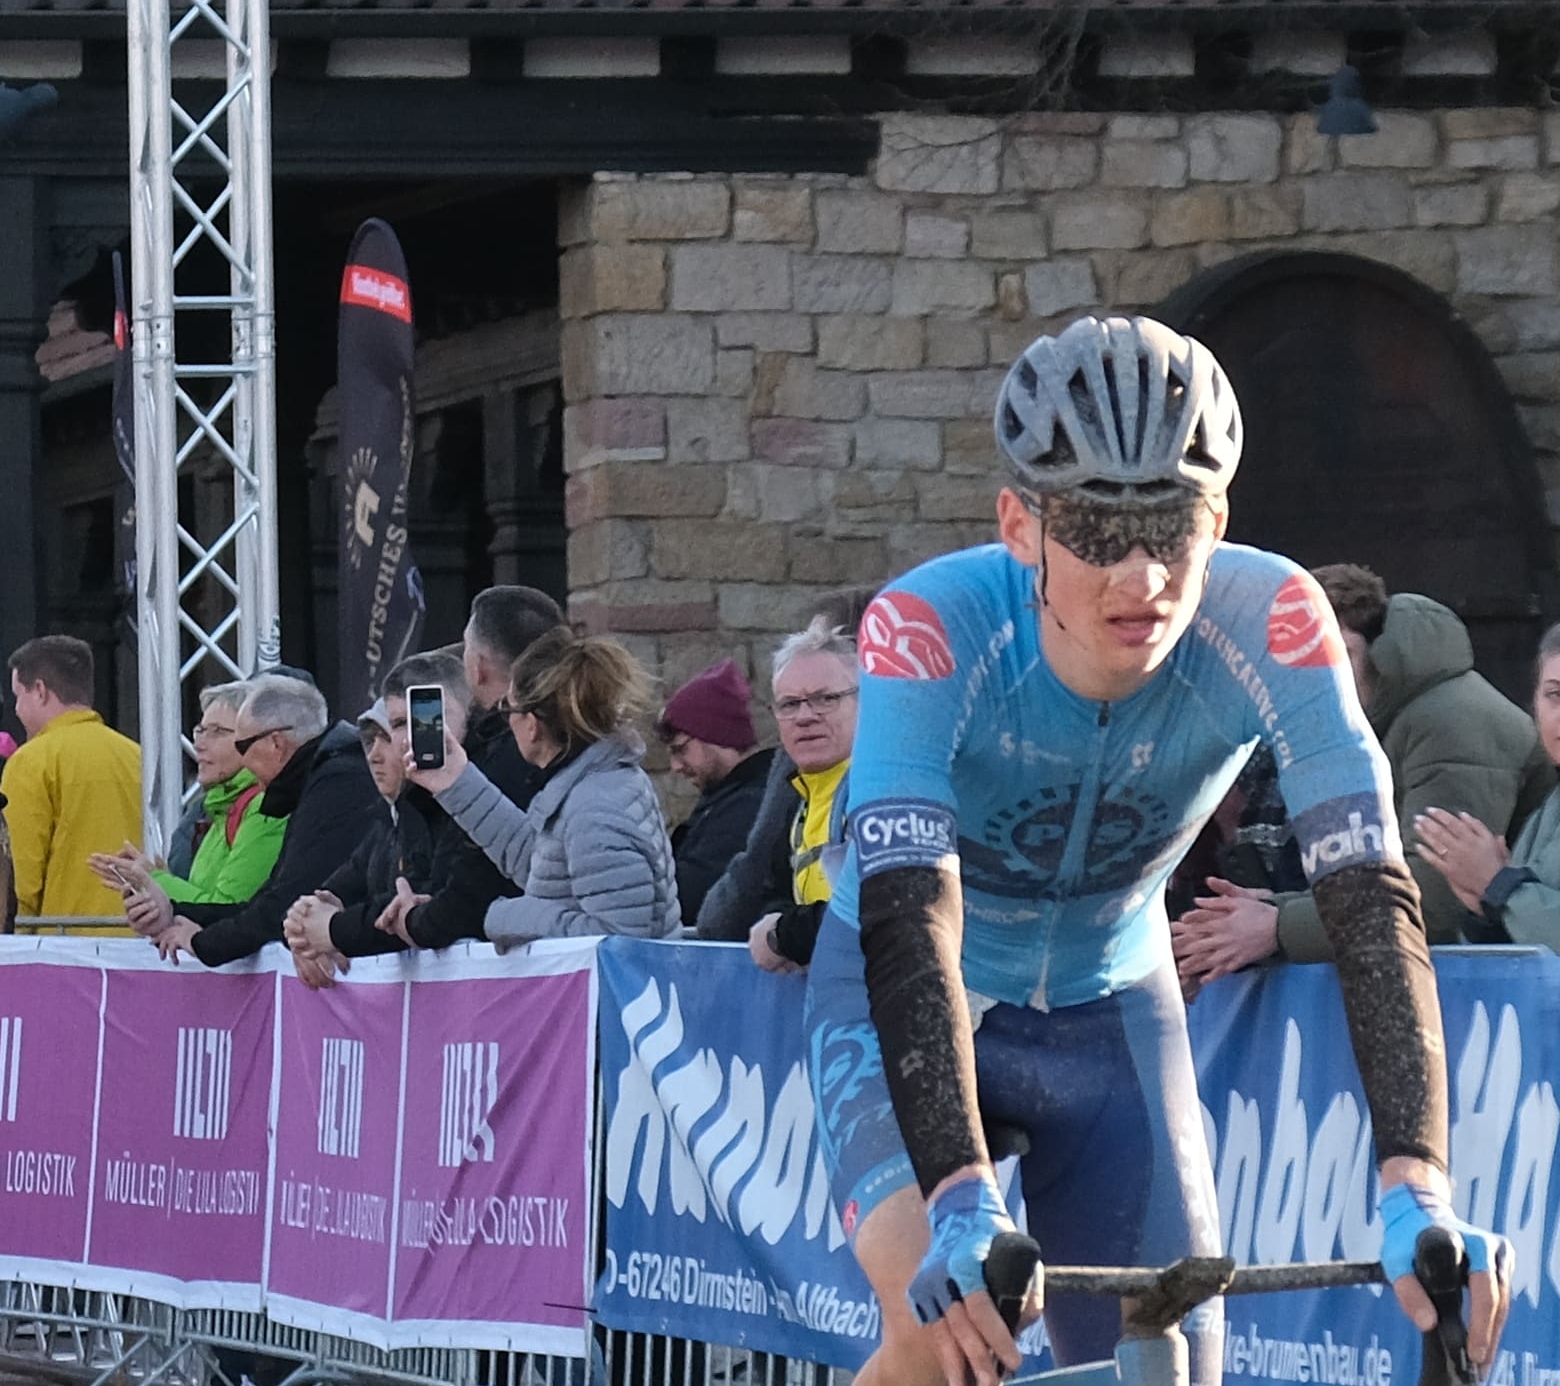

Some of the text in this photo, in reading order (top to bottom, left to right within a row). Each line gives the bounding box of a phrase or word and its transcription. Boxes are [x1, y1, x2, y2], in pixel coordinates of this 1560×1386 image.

[862, 811, 950, 847] Cyclus
[6, 1151, 77, 1198] LOGISTIK
[105, 1150, 167, 1208] MÜLLER
[683, 1258, 769, 1316] Dirmstein
[795, 1280, 880, 1340] Altbach
